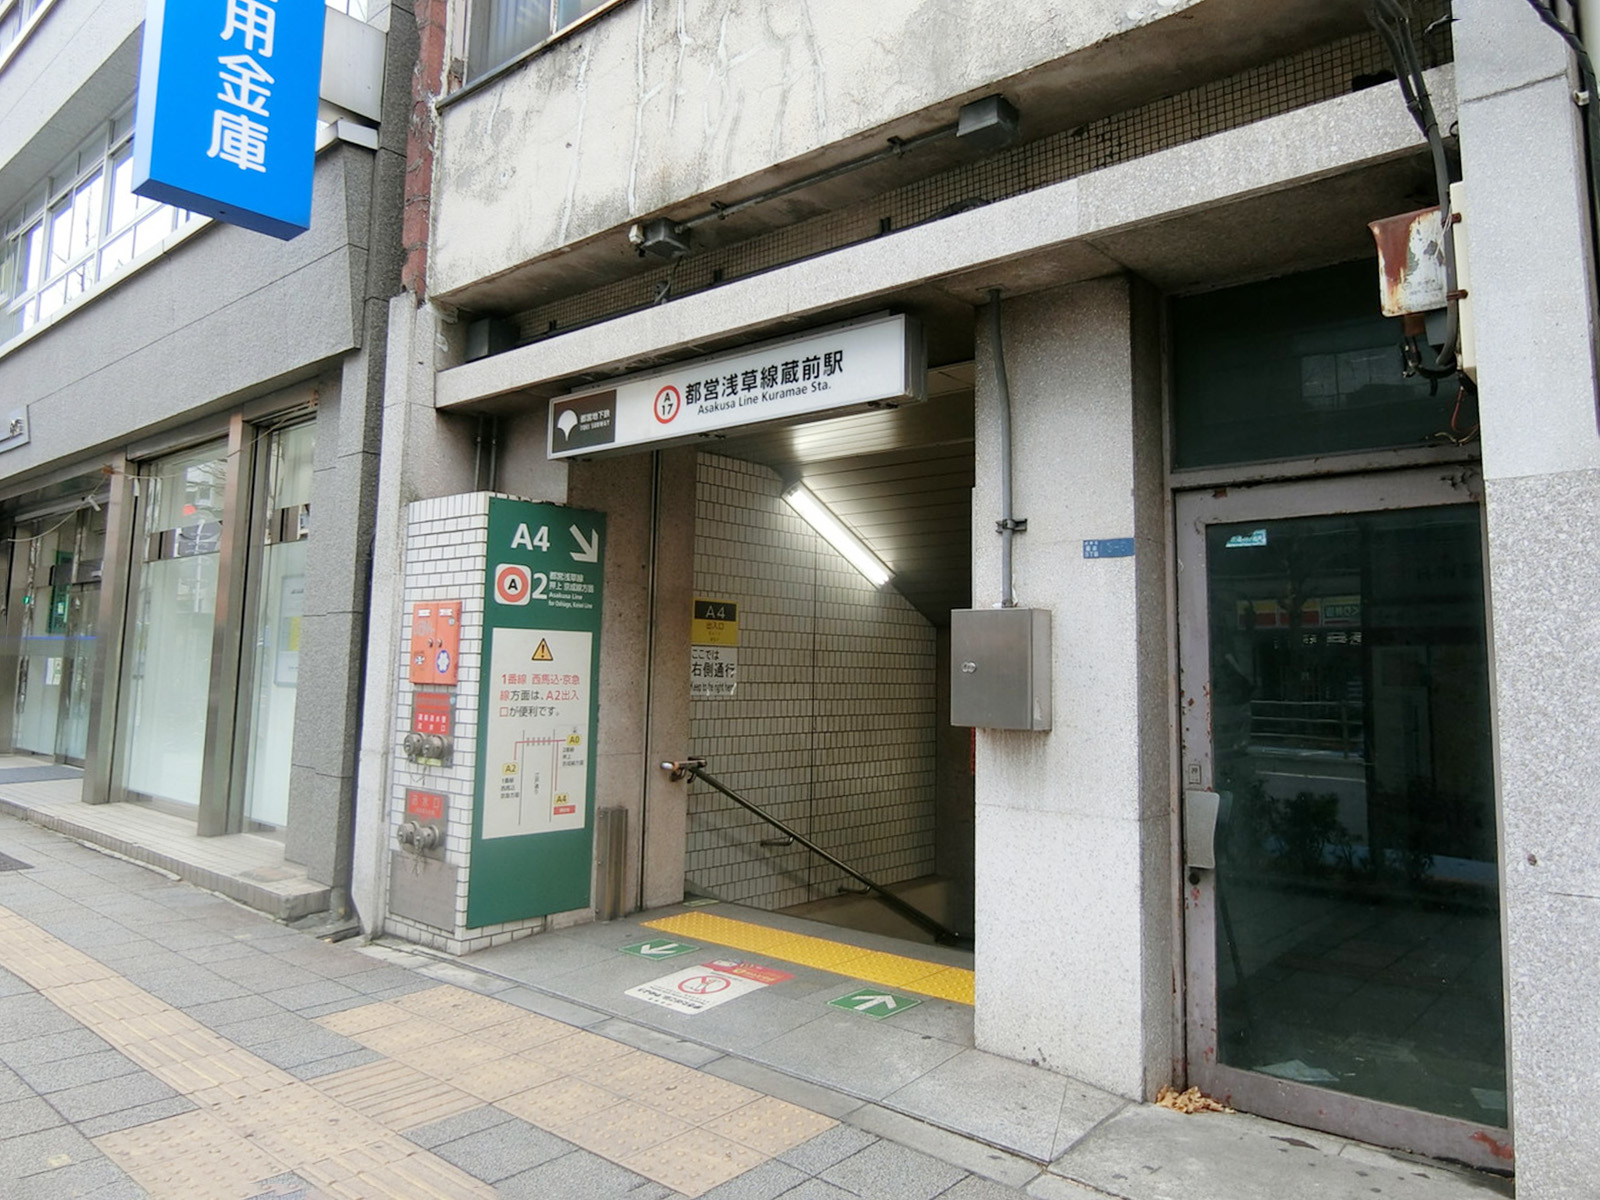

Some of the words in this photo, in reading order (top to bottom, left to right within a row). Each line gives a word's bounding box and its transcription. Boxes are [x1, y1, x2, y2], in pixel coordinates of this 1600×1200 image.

[206, 0, 278, 173] 用金庫
[685, 350, 843, 405] 都営浅草線蔵前駅
[664, 392, 671, 402] A
[698, 399, 736, 415] Asakusa
[739, 394, 759, 407] Line
[762, 384, 808, 401] Kuramae
[811, 380, 832, 392] Sta.
[661, 403, 674, 416] 17
[510, 523, 550, 552] A4
[507, 578, 518, 590] A
[706, 605, 726, 619] A4
[692, 649, 719, 660] ここでは
[691, 662, 735, 678] 右側通行
[502, 674, 527, 685] 1番線
[505, 764, 516, 772] A2
[556, 795, 567, 803] A4
